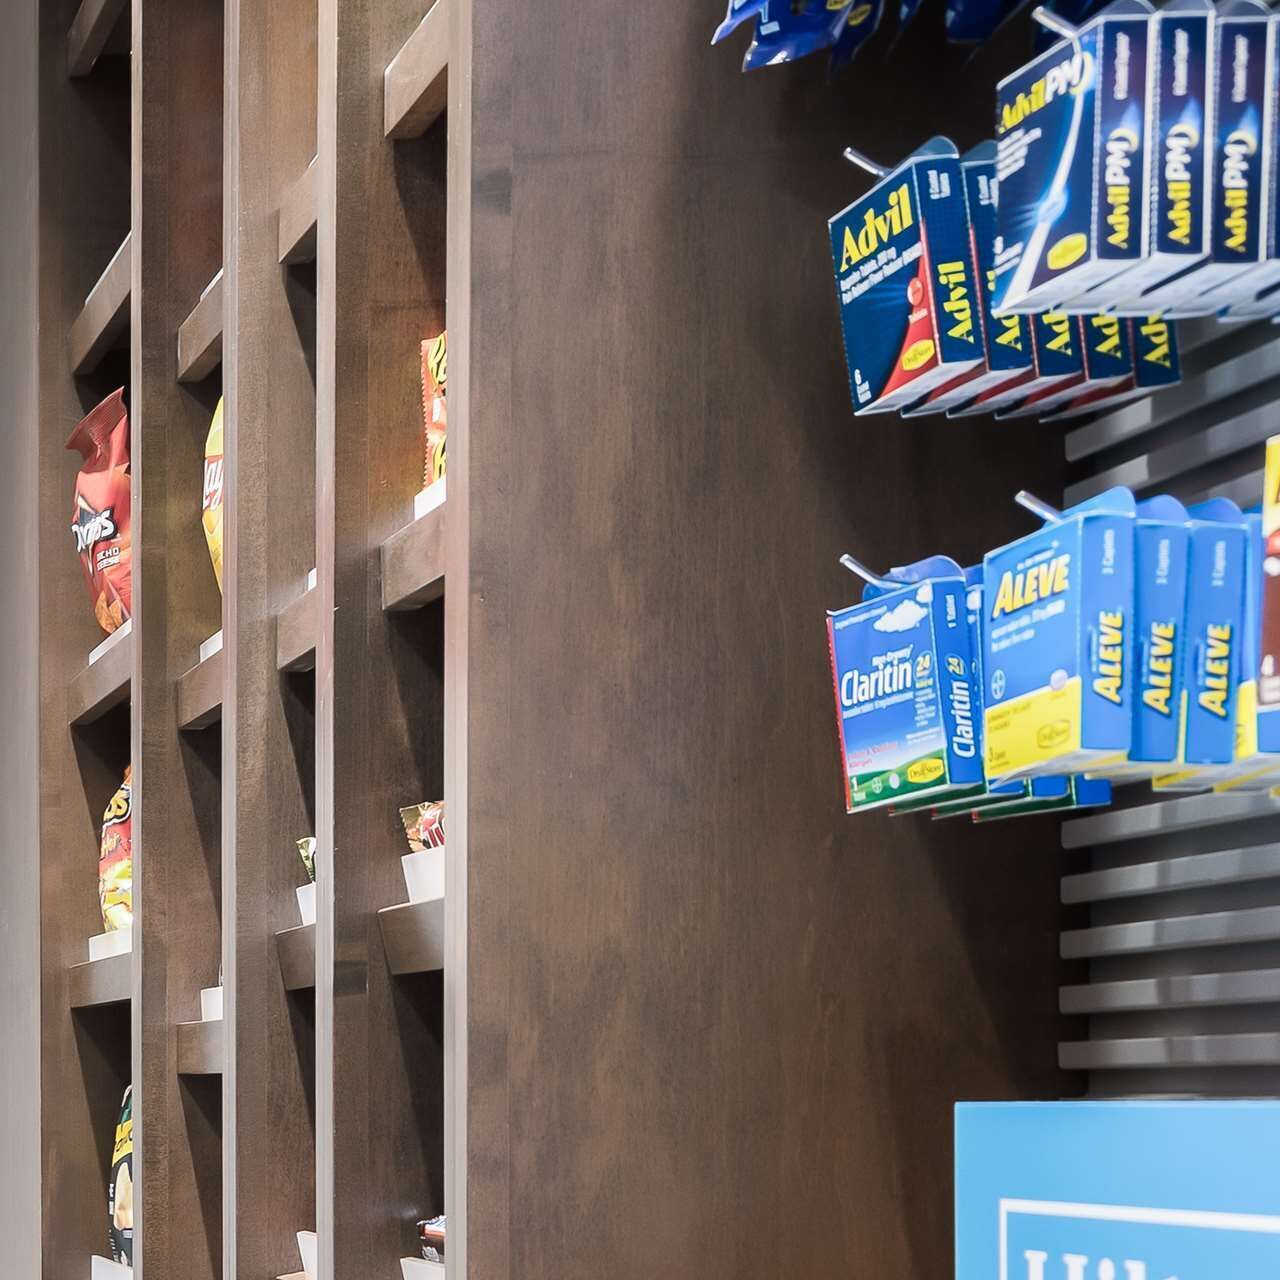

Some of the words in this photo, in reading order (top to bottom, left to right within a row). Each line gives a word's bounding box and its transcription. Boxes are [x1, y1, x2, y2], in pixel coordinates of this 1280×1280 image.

[840, 184, 914, 272] Advil
[938, 262, 975, 344] Advil
[991, 553, 1072, 619] ALEVE
[840, 658, 913, 707] Claritin
[1093, 611, 1123, 704] ALEVE
[1143, 622, 1174, 715] ALEVE
[1198, 623, 1230, 717] ALEVE
[951, 680, 976, 760] Claritin
